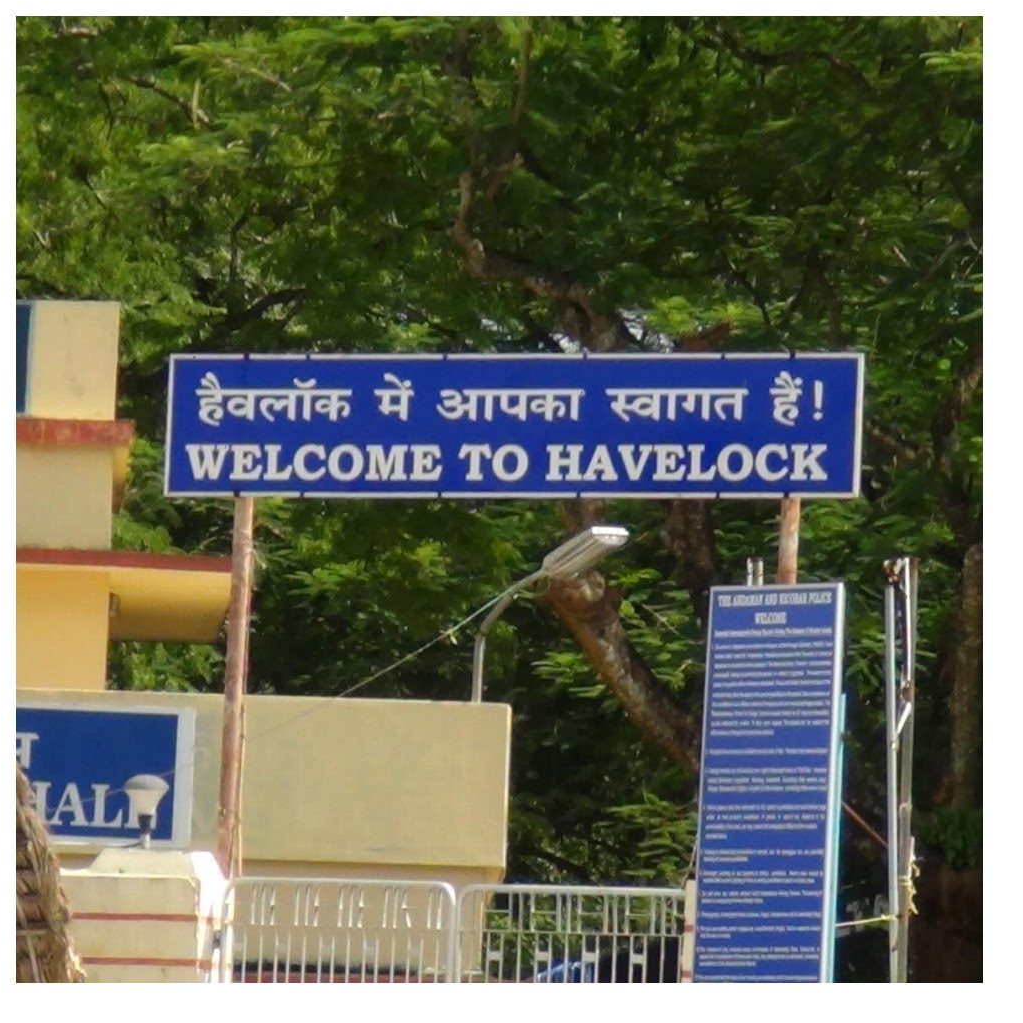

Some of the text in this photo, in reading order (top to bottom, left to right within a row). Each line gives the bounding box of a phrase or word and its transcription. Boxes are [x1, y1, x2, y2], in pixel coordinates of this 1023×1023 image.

[195, 371, 353, 427] हैवलॉक
[374, 372, 415, 422] में
[436, 388, 586, 422] आपका
[605, 387, 749, 422] स्वागत
[185, 443, 828, 482] WELCOME TO HAVELOCK
